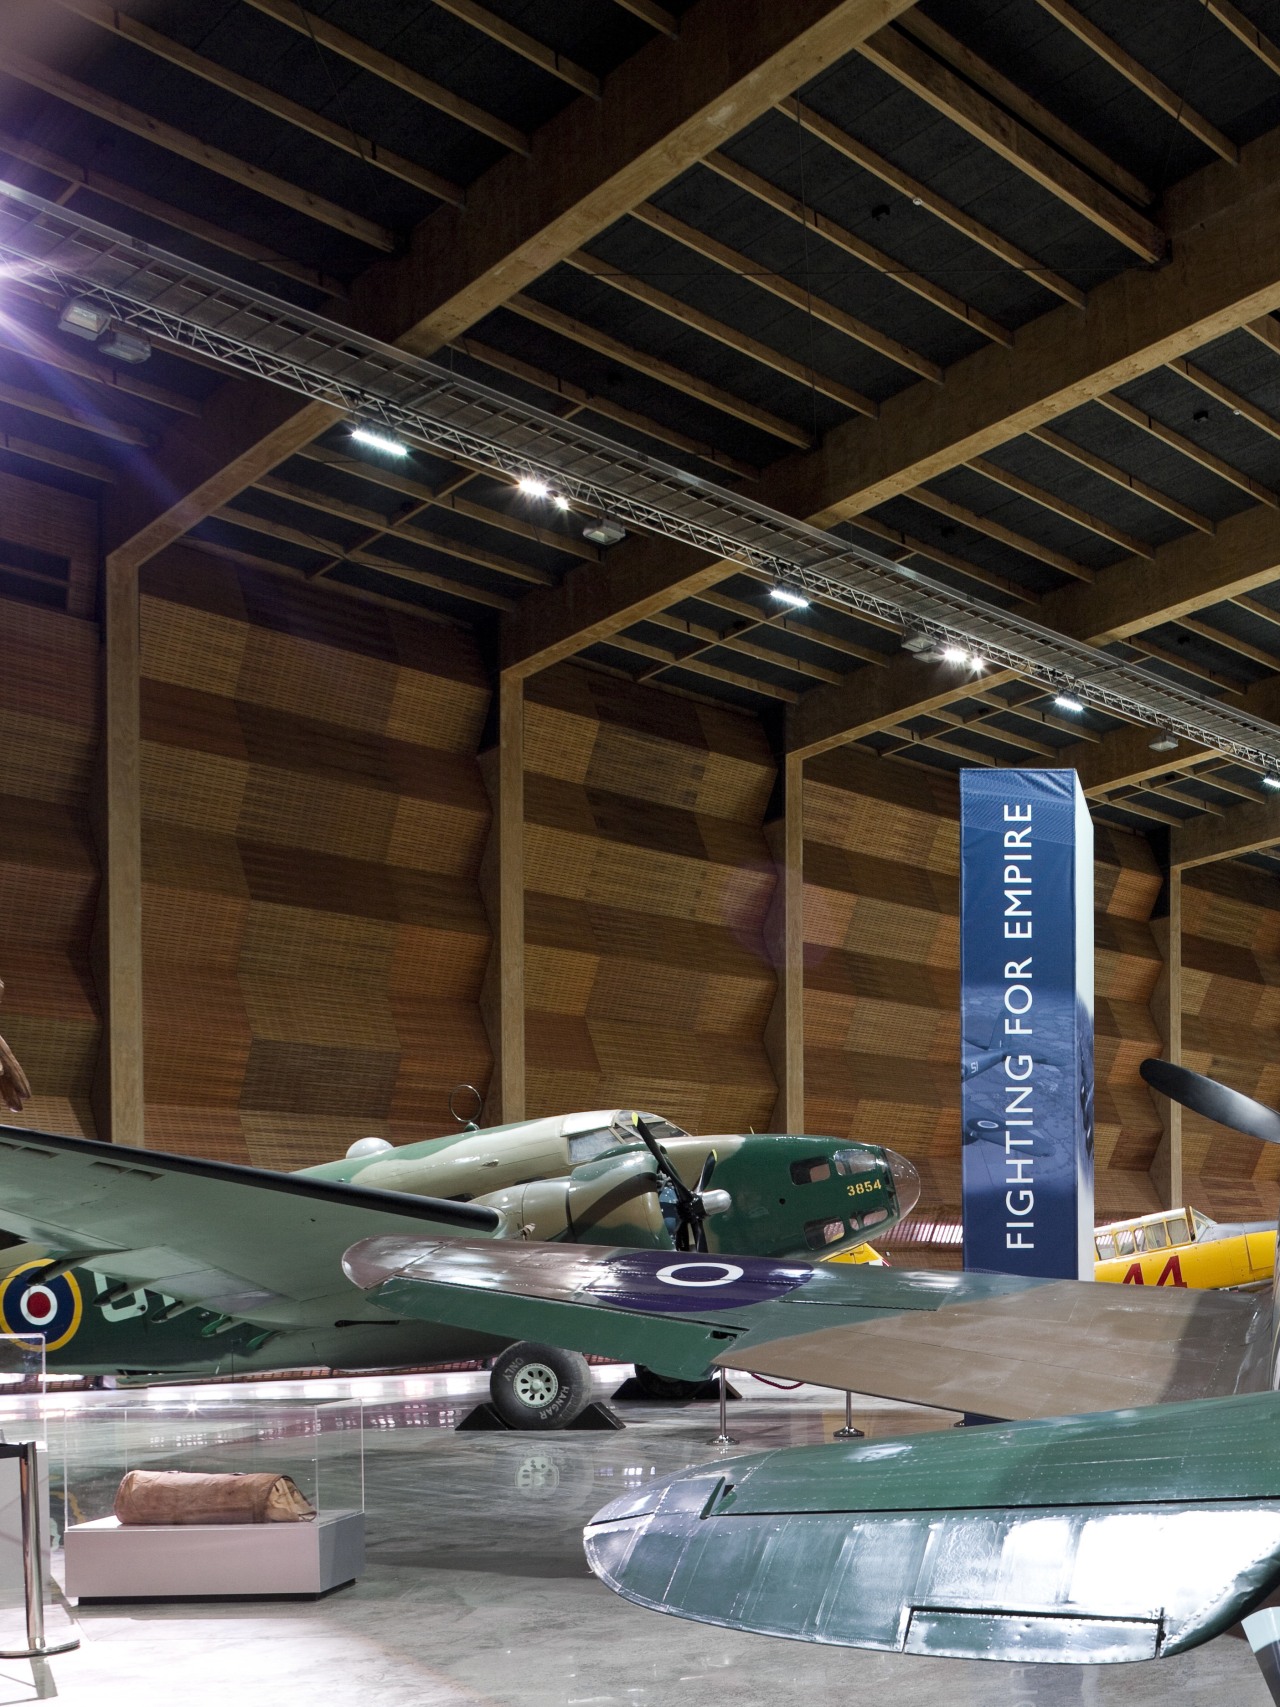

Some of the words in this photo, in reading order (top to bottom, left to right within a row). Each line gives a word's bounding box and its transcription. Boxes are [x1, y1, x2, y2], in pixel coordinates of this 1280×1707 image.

[1003, 803, 1033, 939] EMPIRE
[1004, 956, 1034, 1036] FOR
[1004, 1054, 1035, 1249] FIGHTING
[846, 1179, 882, 1197] 3854
[502, 1357, 525, 1382] ONLY
[539, 1385, 570, 1420] HANGAR
